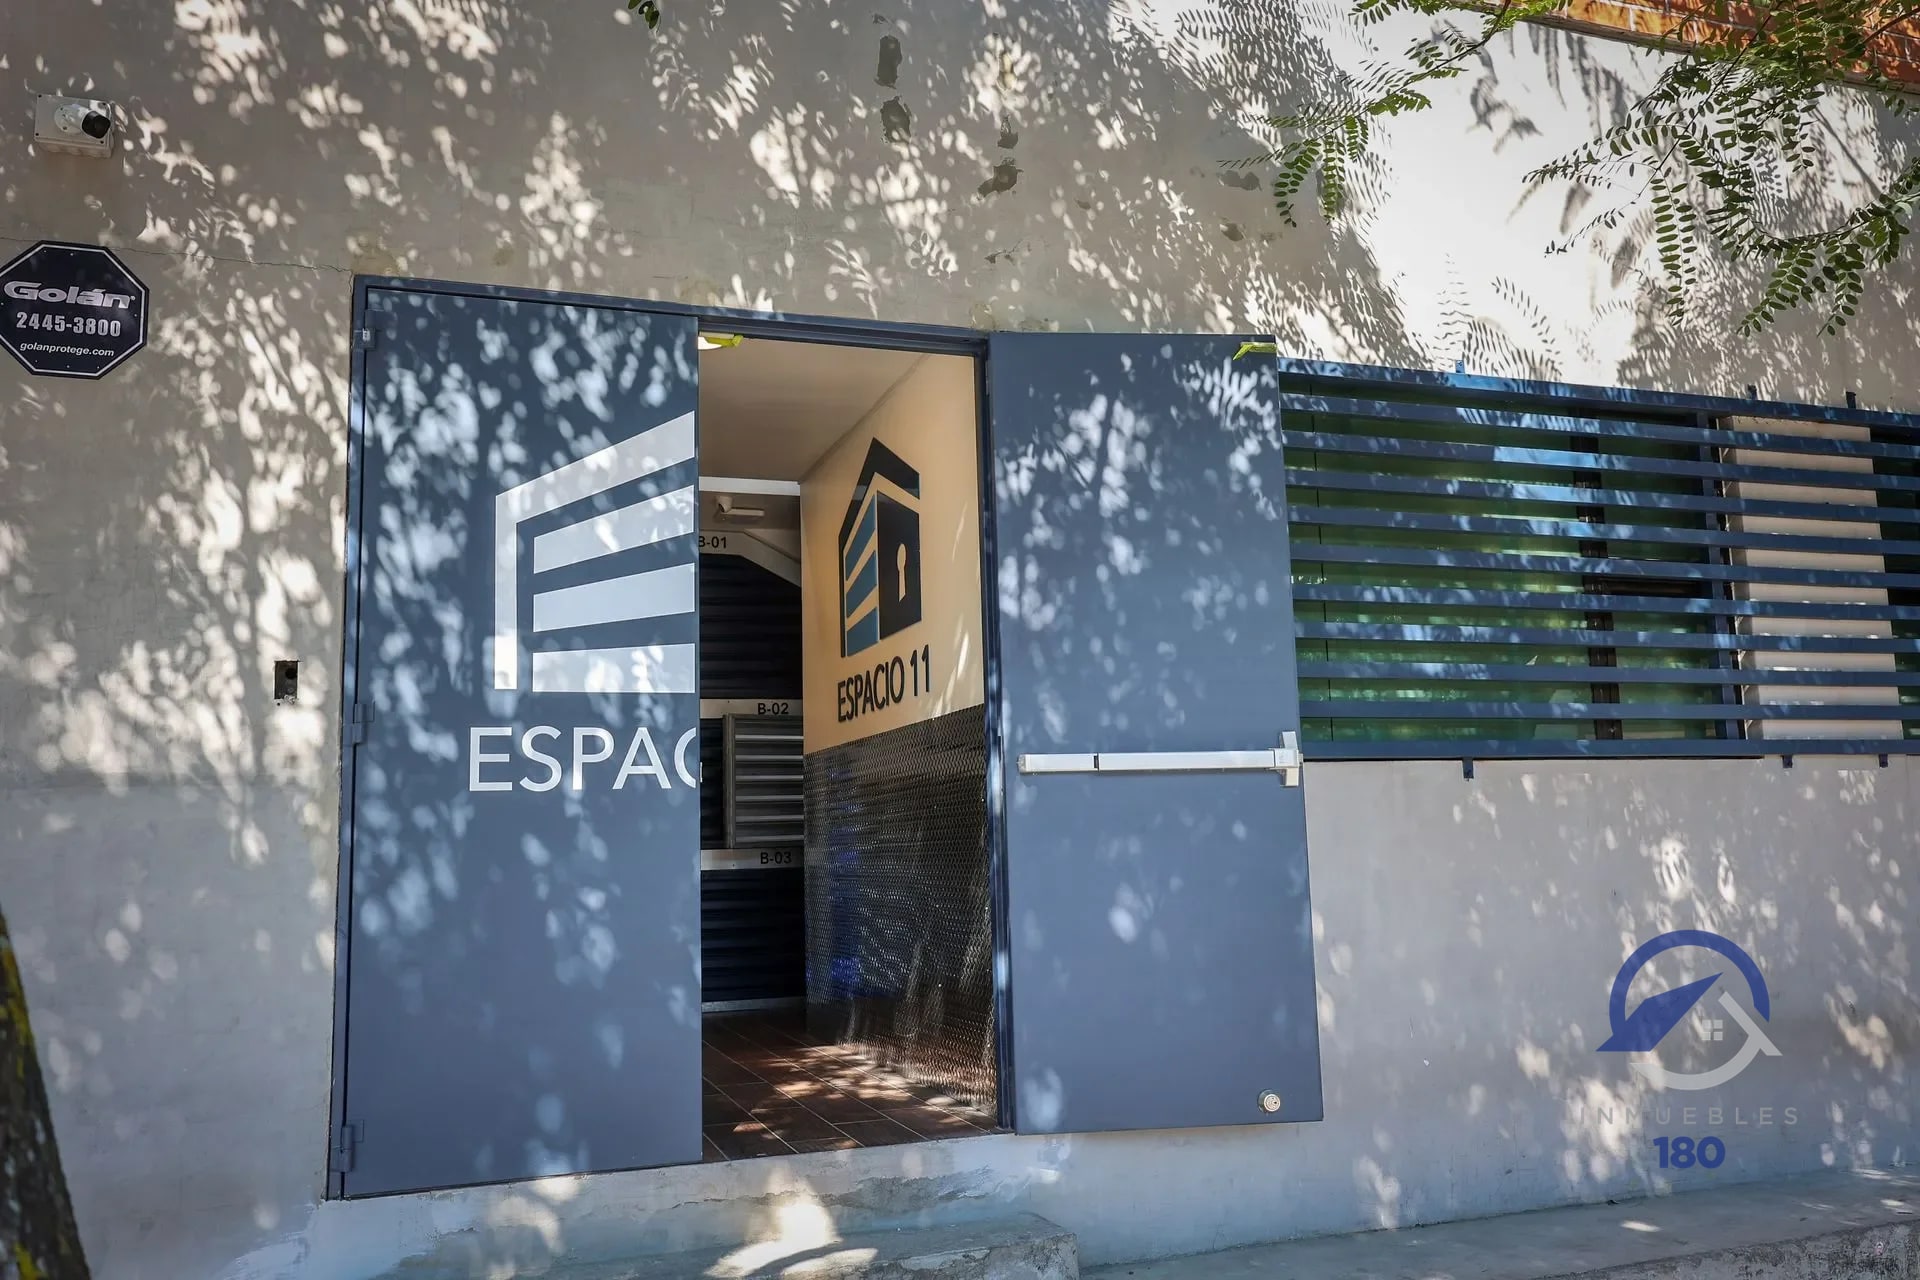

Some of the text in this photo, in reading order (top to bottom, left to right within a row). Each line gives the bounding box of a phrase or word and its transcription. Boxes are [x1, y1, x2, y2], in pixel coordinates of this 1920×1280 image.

[16, 312, 121, 337] 2445-3800
[20, 342, 115, 357] golanprotege.com
[837, 644, 930, 723] ESPACIO 11
[757, 702, 789, 715] B-02
[760, 852, 792, 865] B-03
